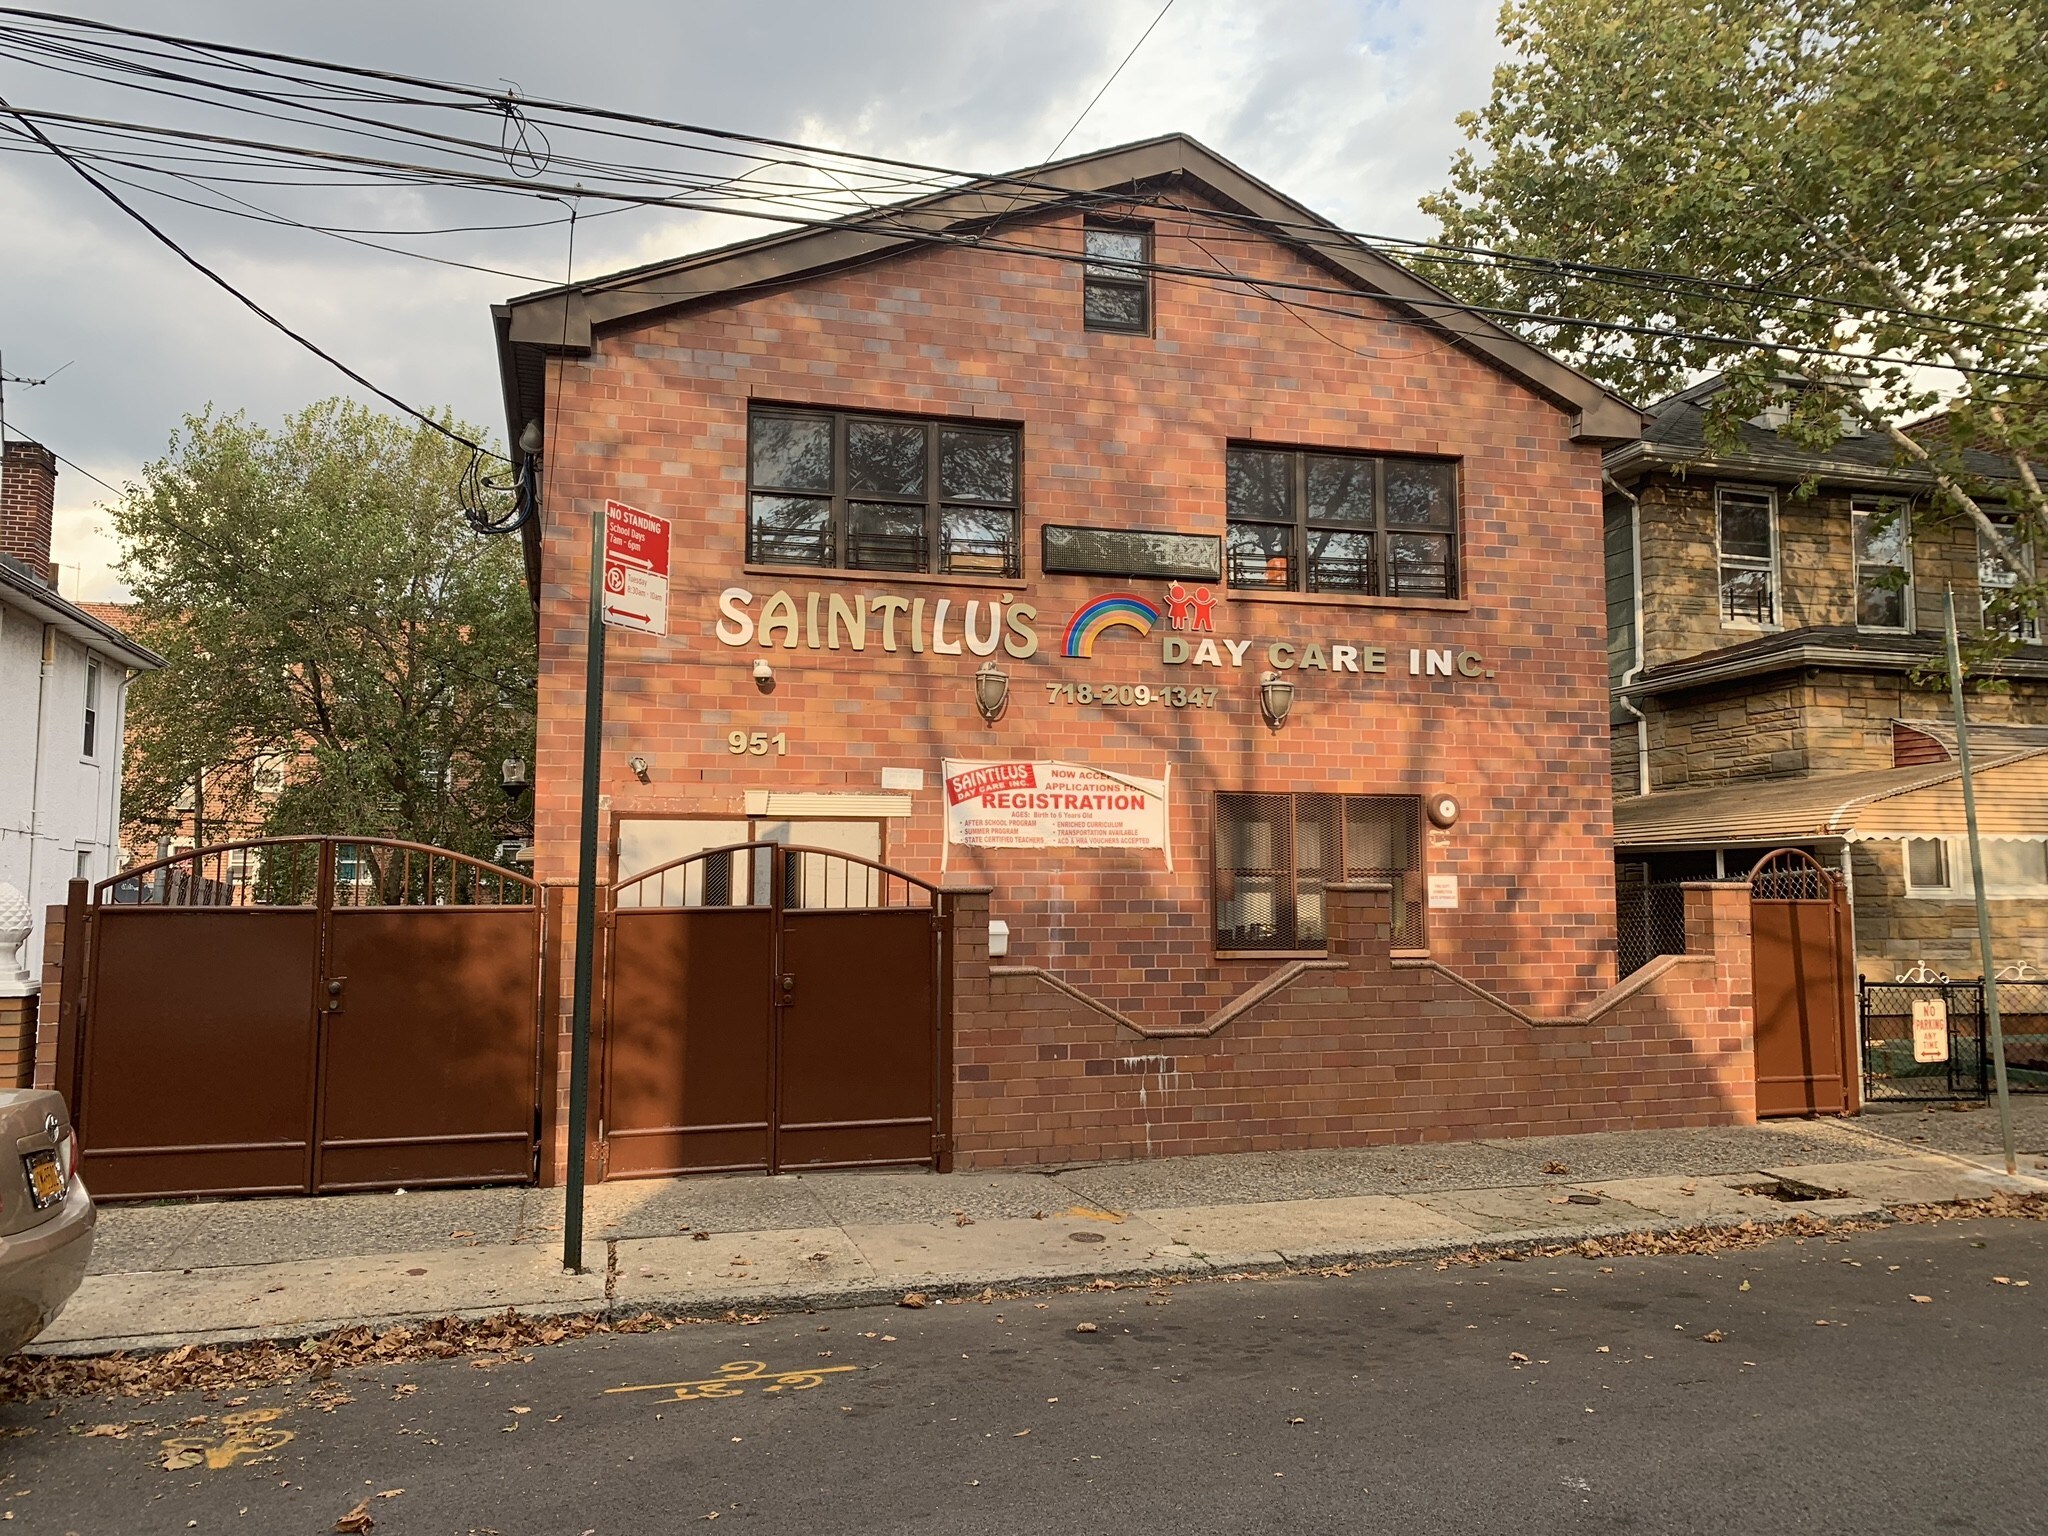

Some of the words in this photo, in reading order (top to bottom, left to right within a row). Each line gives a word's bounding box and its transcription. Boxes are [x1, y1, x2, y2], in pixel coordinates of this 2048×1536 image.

[610, 506, 621, 520] NO
[623, 511, 661, 534] STANDING
[610, 521, 630, 536] School
[631, 529, 646, 542] Days
[609, 532, 623, 546] 7am
[627, 539, 641, 552] 6pm
[1162, 637, 1251, 667] DAY
[1268, 642, 1387, 673] CARE
[1409, 648, 1496, 678] INC.
[1046, 682, 1219, 708] 718-209-1347
[728, 730, 786, 756] 951
[953, 764, 1028, 793] SAINTILUS
[1051, 770, 1076, 778] NOW
[1078, 771, 1110, 780] ACCE
[957, 788, 976, 800] DAY
[979, 782, 1006, 793] CARE
[1009, 779, 1030, 788] INC.
[1045, 783, 1120, 792] APPLICATIONS
[983, 793, 1145, 809] REGISTRATION
[1923, 1006, 1936, 1017] NO
[1916, 1019, 1944, 1030] PARKING
[1922, 1041, 1939, 1049] TIME
[1924, 1032, 1936, 1040] ANY
